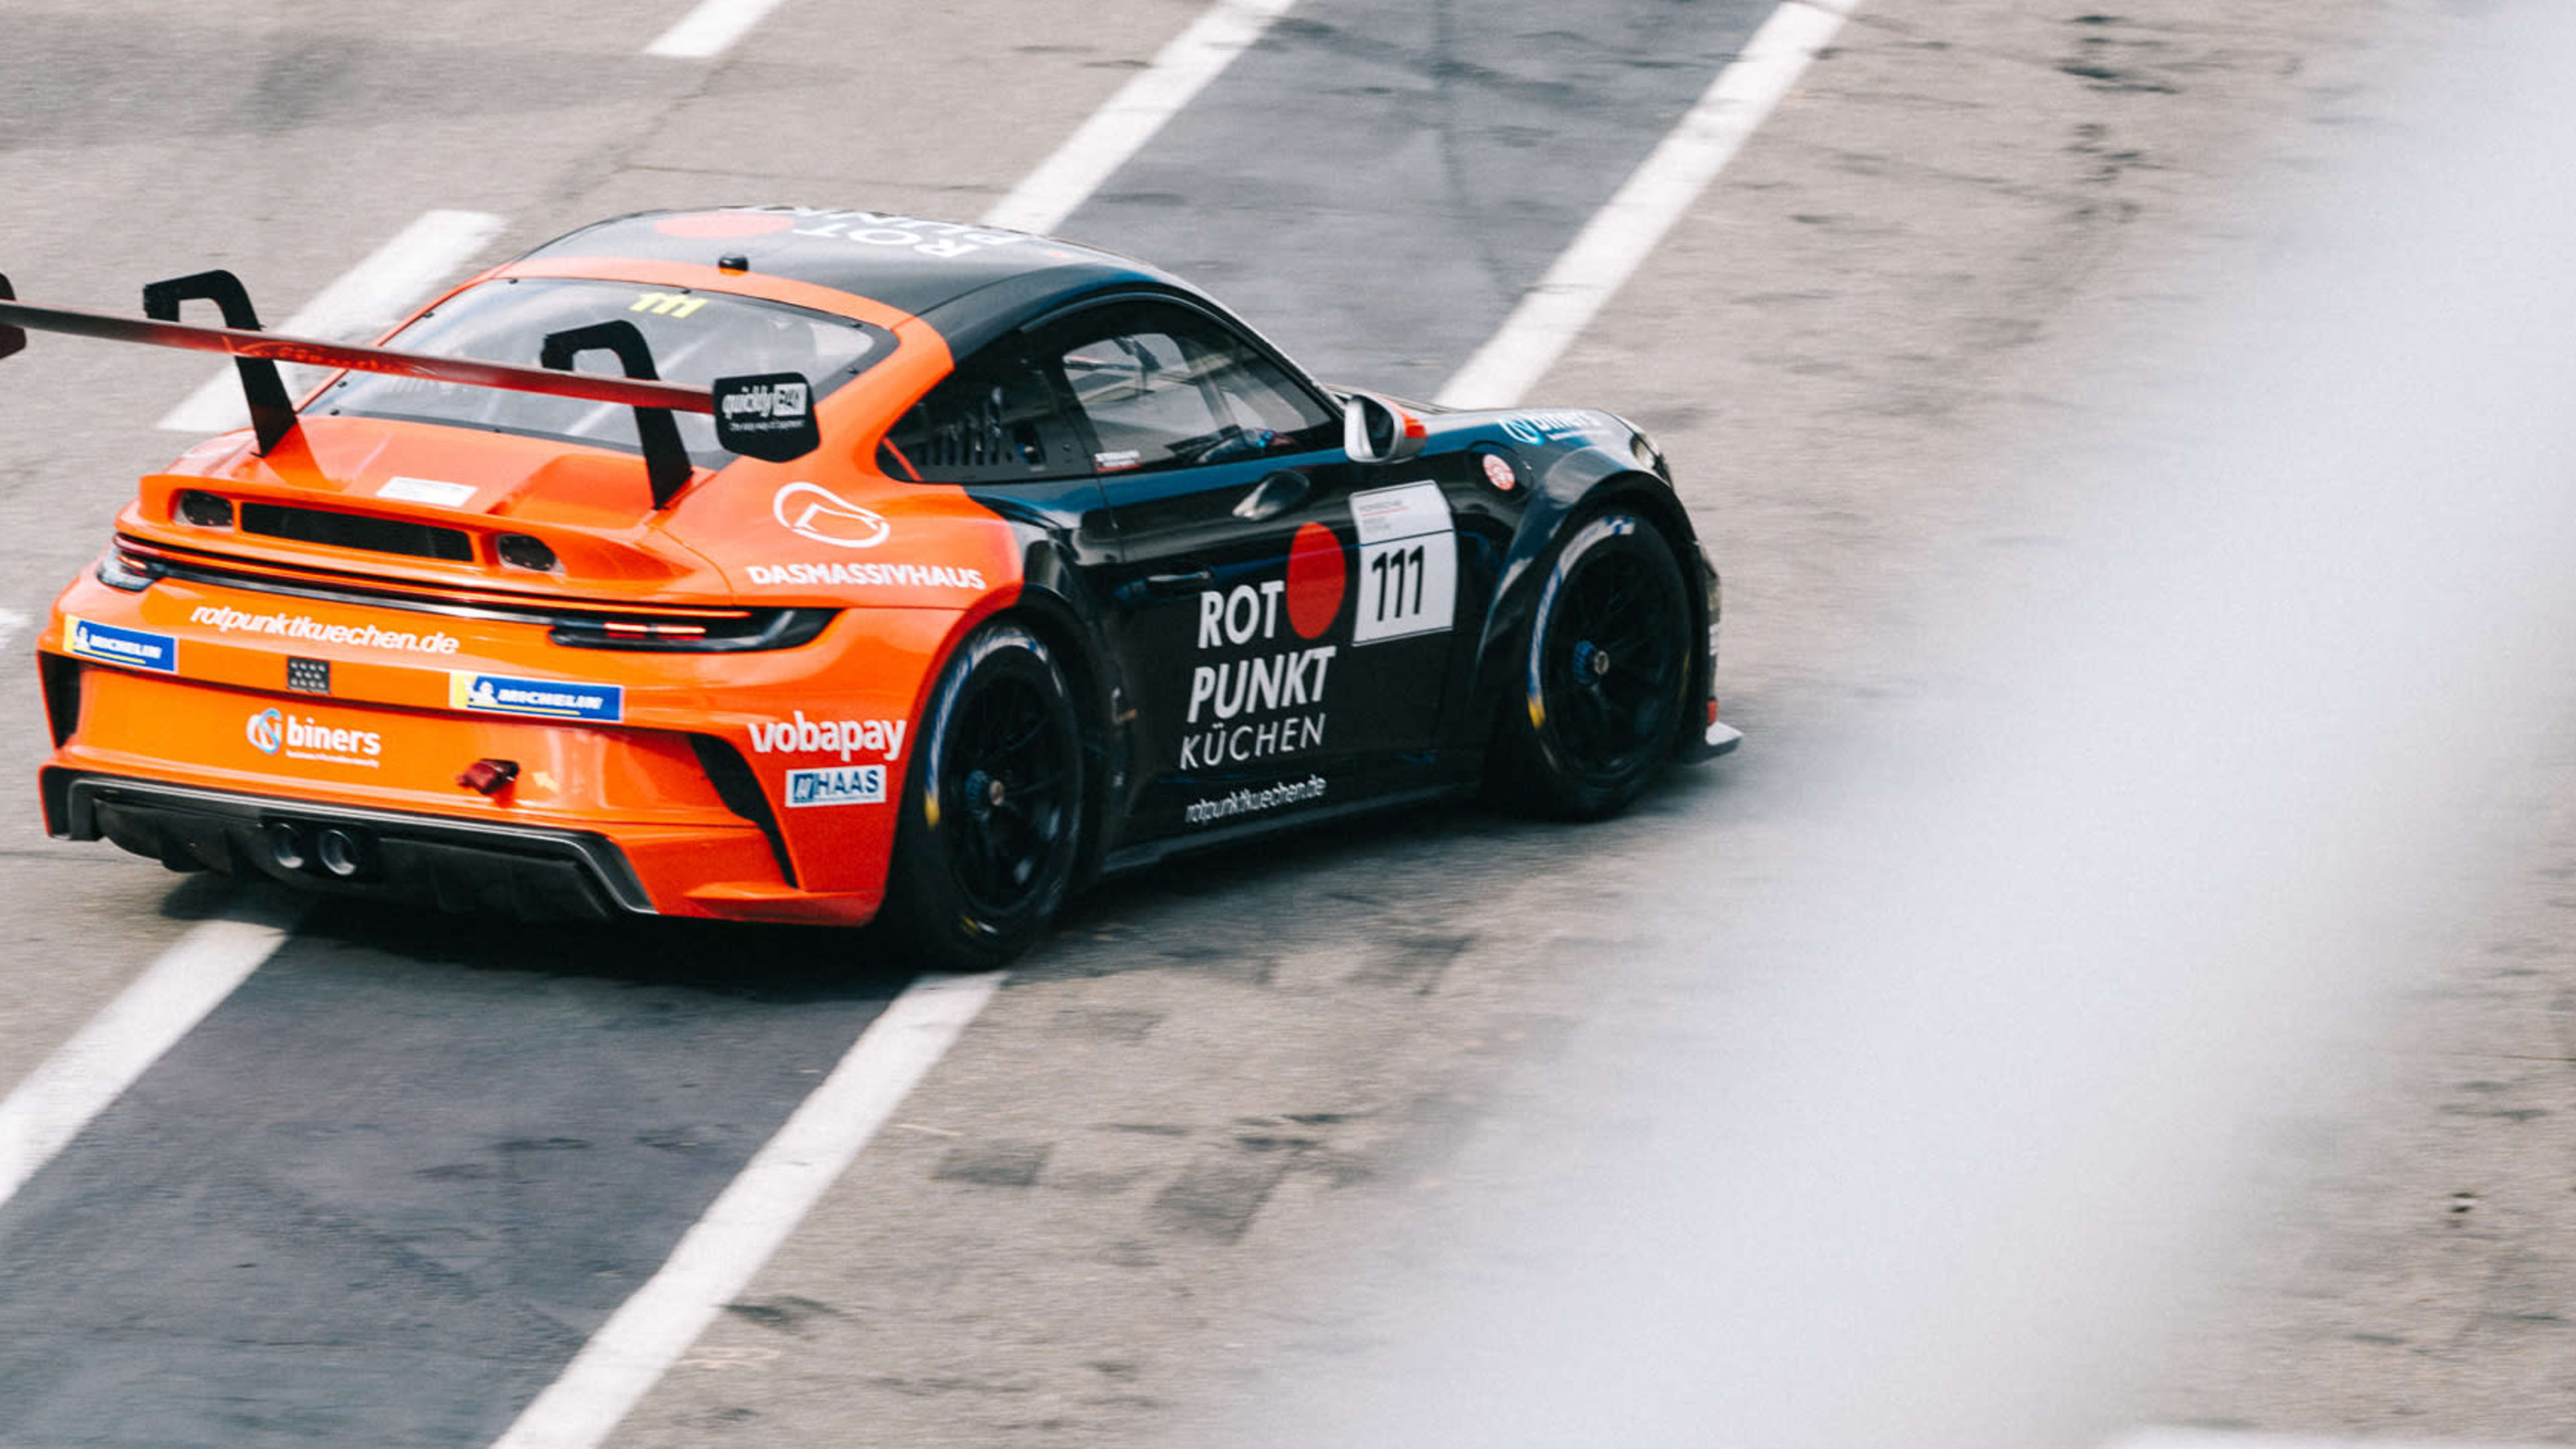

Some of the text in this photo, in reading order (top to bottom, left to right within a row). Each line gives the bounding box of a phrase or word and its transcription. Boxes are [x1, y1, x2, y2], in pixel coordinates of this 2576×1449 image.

[792, 223, 980, 258] ROT
[629, 292, 708, 319] 111
[746, 563, 987, 590] DASMASSIVHAUS
[1371, 544, 1424, 622] 111
[190, 606, 460, 654] rotpunktkuechen.de
[1197, 580, 1284, 649] ROT
[497, 689, 604, 710] MICHELIN
[1187, 646, 1336, 724] PUNKT
[286, 715, 381, 755] biners
[747, 710, 907, 761] vobapay
[1180, 712, 1326, 770] KÜCHEN
[815, 769, 879, 796] HAAS
[1185, 773, 1327, 825] rotpunktkuechen.de
